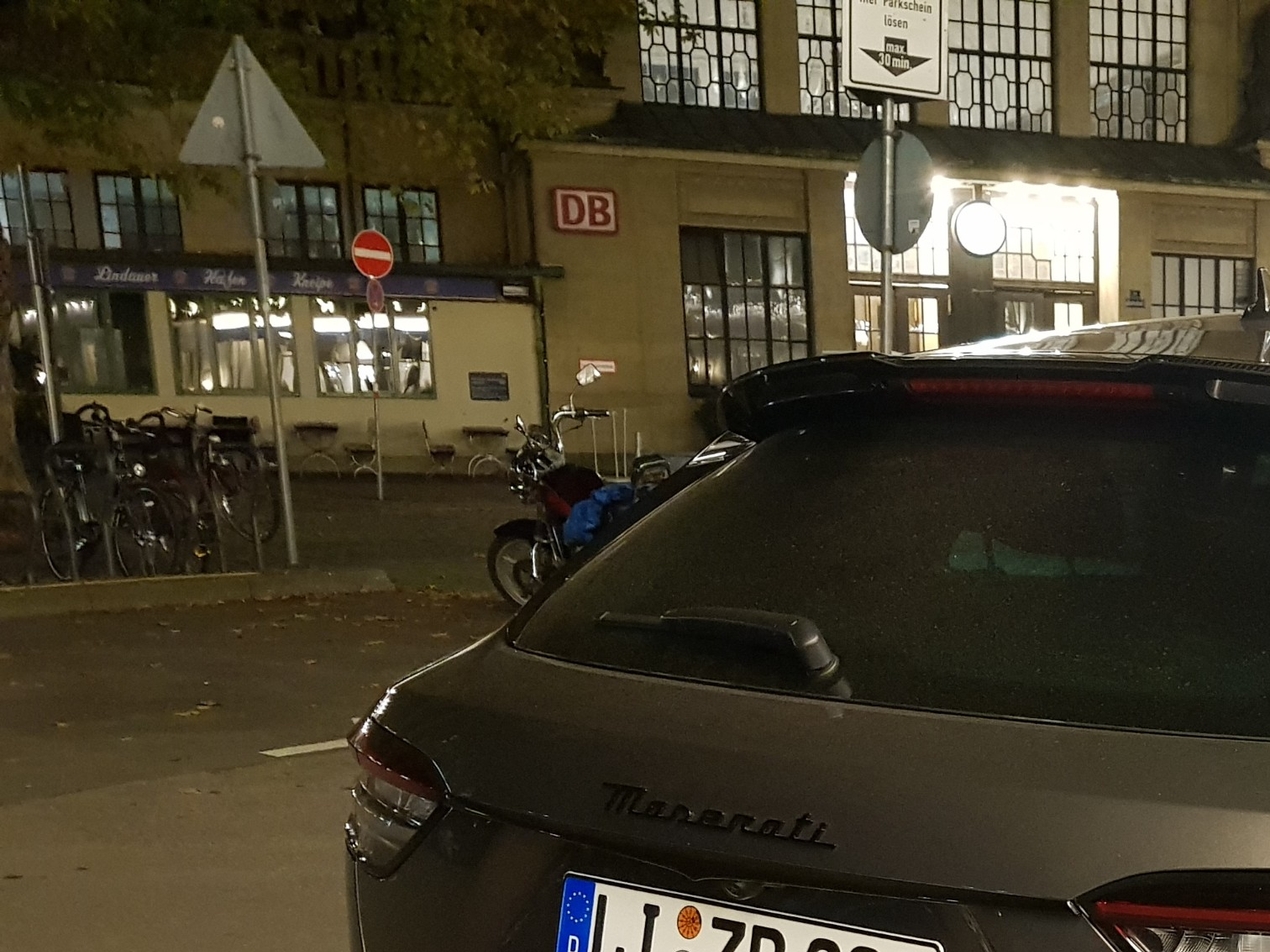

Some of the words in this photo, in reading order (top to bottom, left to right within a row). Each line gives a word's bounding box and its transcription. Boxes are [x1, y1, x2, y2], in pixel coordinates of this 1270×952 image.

[884, 14, 908, 29] lösen
[886, 43, 907, 55] max.
[560, 193, 611, 227] DB
[93, 264, 159, 284] Lindauer
[203, 268, 247, 290] Hafen
[291, 271, 335, 293] Kneipe
[602, 781, 838, 850] Maserati
